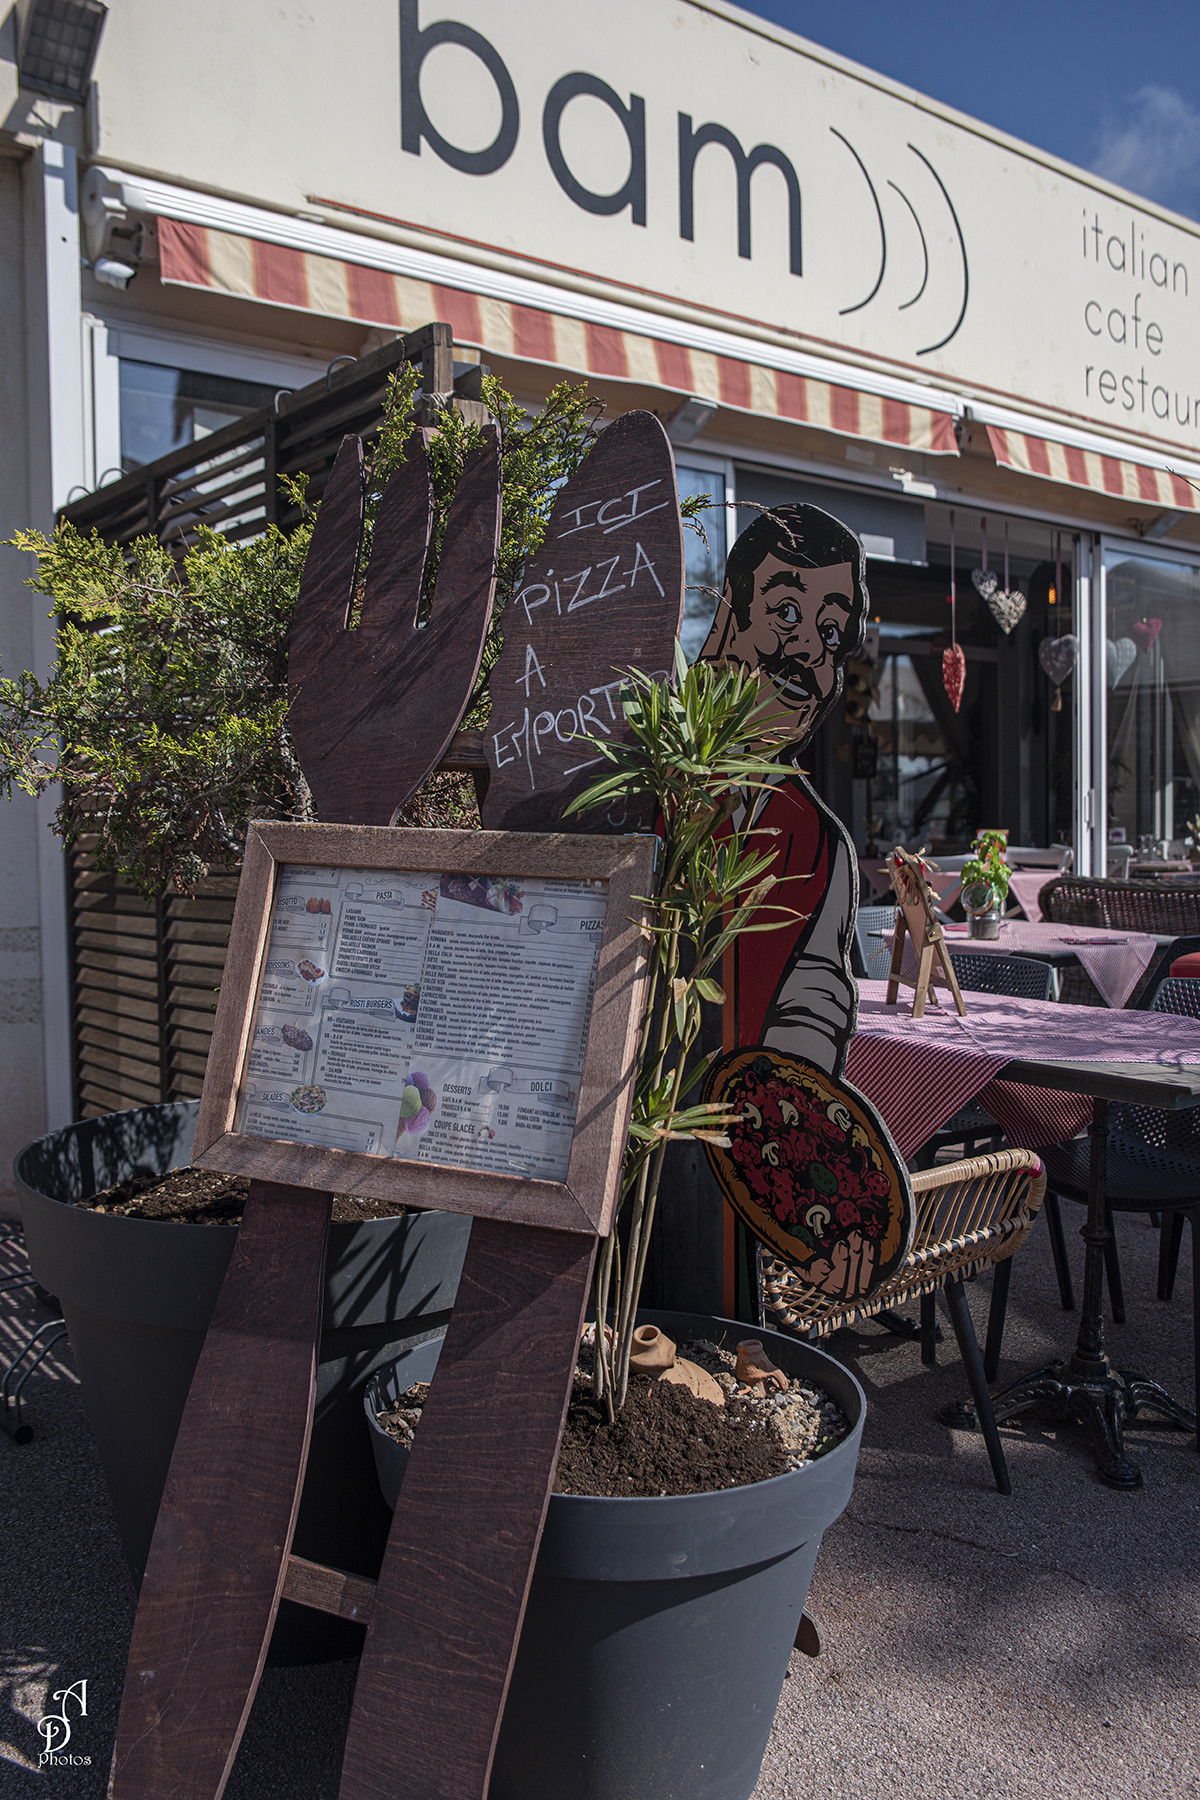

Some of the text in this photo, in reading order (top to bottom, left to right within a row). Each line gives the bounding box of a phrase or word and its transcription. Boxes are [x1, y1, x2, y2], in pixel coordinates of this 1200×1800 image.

[399, 0, 802, 277] bam
[1083, 208, 1188, 297] italian
[1084, 292, 1164, 356] cafe
[557, 479, 669, 538] ICI
[376, 892, 393, 900] PASTA
[366, 1000, 393, 1008] BURGERS
[442, 1084, 472, 1095] DESSERTS
[530, 1082, 552, 1092] DOLCI
[434, 1119, 475, 1134] COUPE GLACÉE
